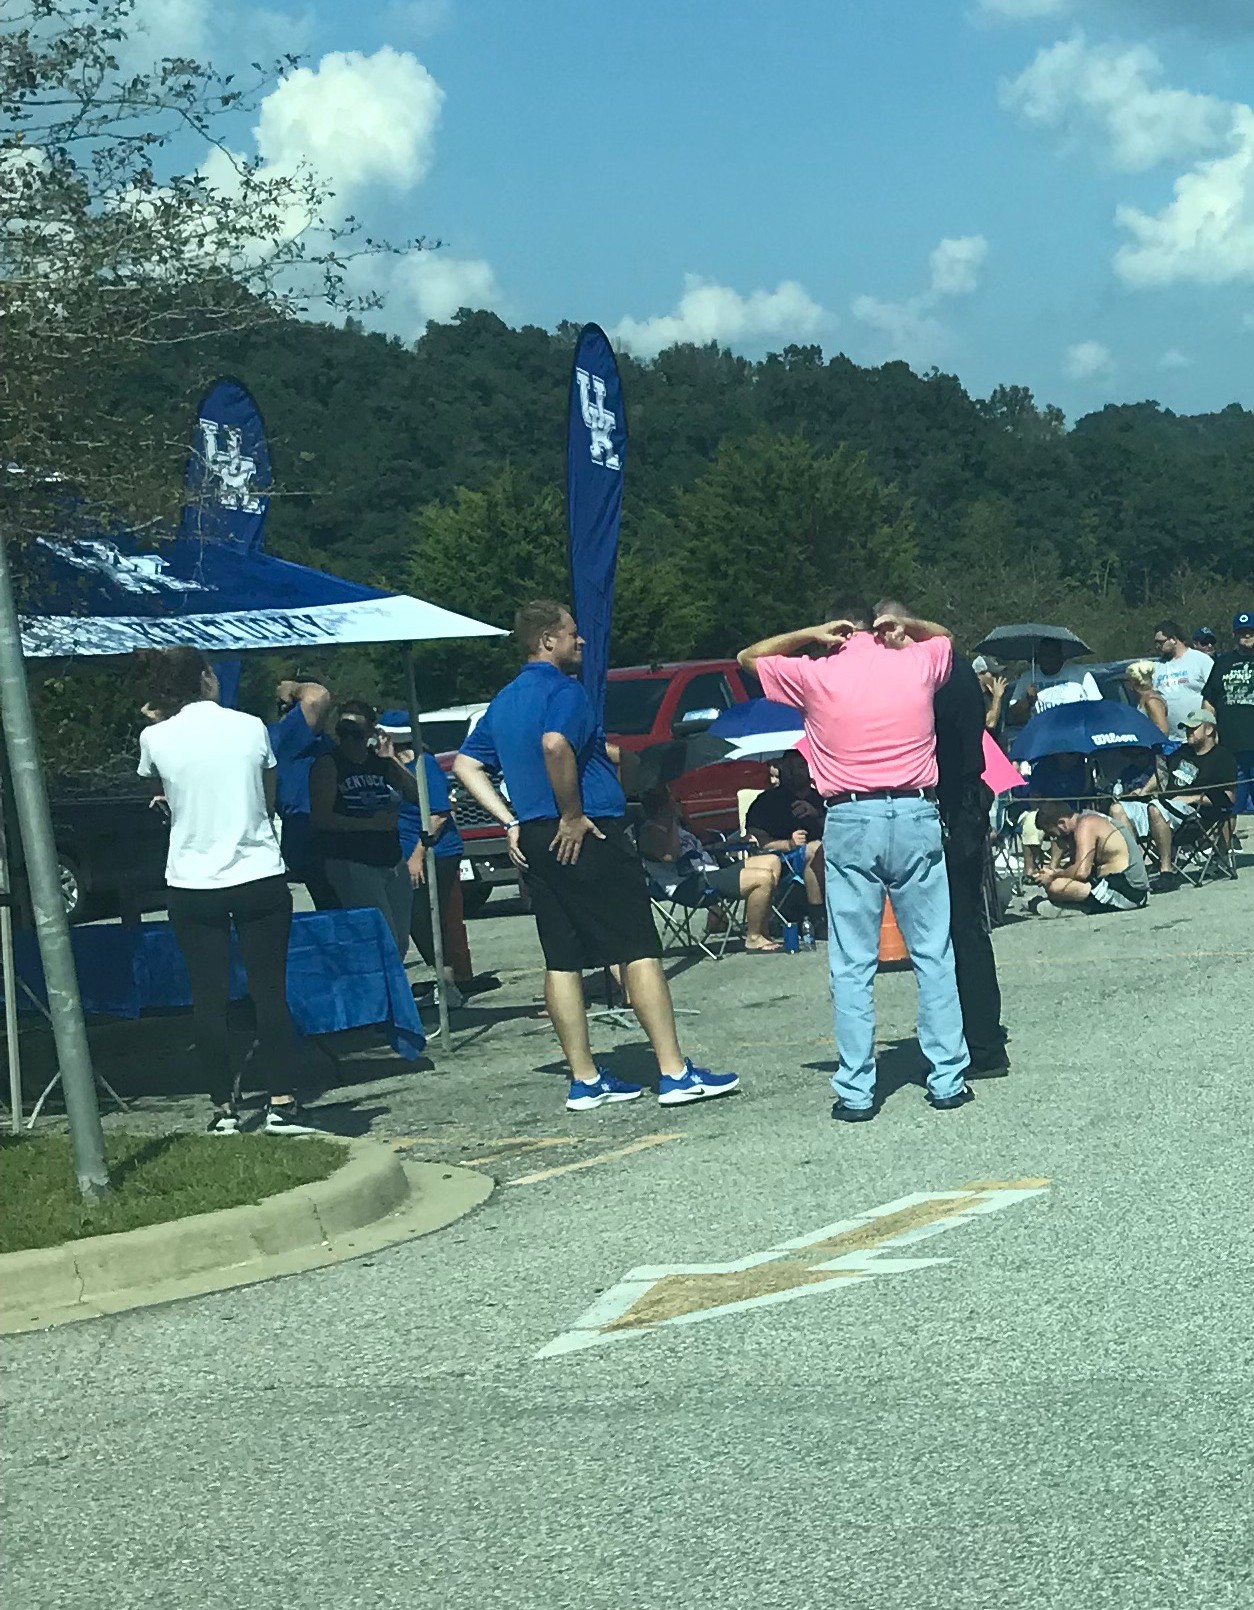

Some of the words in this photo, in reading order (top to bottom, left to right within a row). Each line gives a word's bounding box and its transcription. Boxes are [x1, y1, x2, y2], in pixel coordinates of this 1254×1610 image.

[576, 367, 621, 471] UK
[119, 613, 336, 645] KENTUCKY
[1091, 732, 1139, 746] Wilson
[338, 774, 388, 793] KENTUCK
